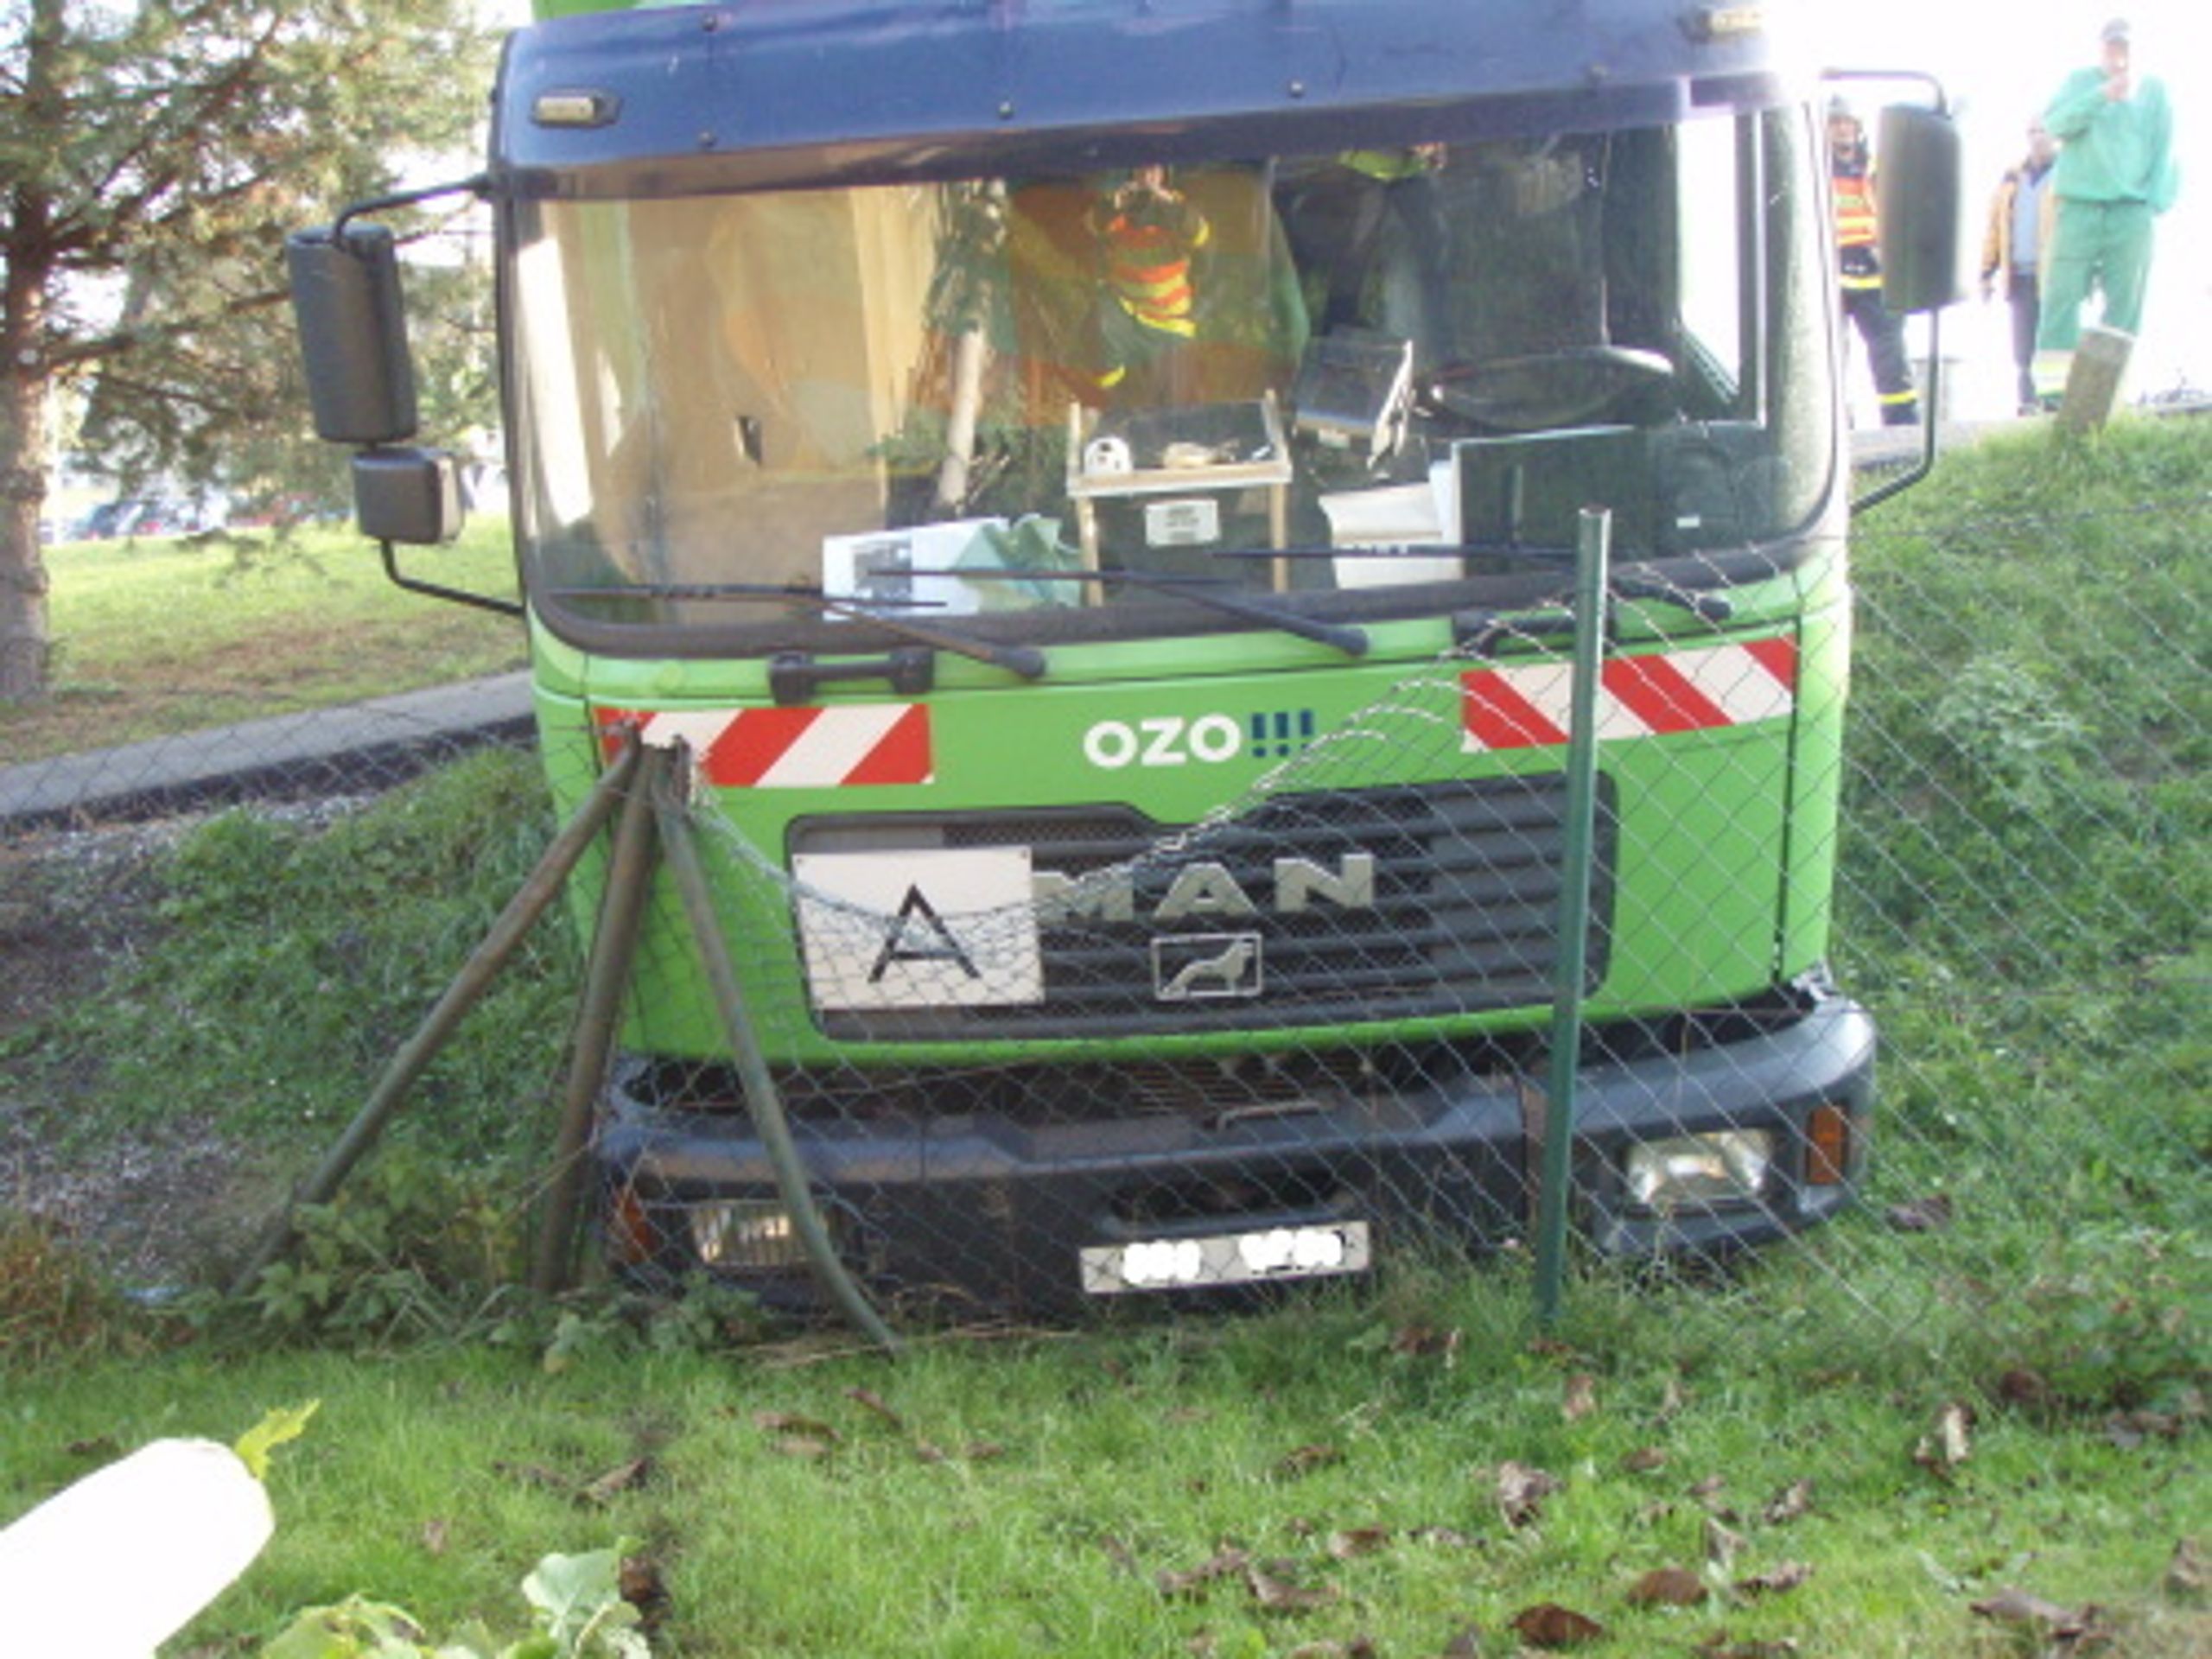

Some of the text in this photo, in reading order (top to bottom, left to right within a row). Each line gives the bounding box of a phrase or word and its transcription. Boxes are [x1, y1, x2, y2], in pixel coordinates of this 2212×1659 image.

[1084, 708, 1314, 769] OZO!!!
[1033, 852, 1376, 923] MAN
[868, 883, 983, 983] A
